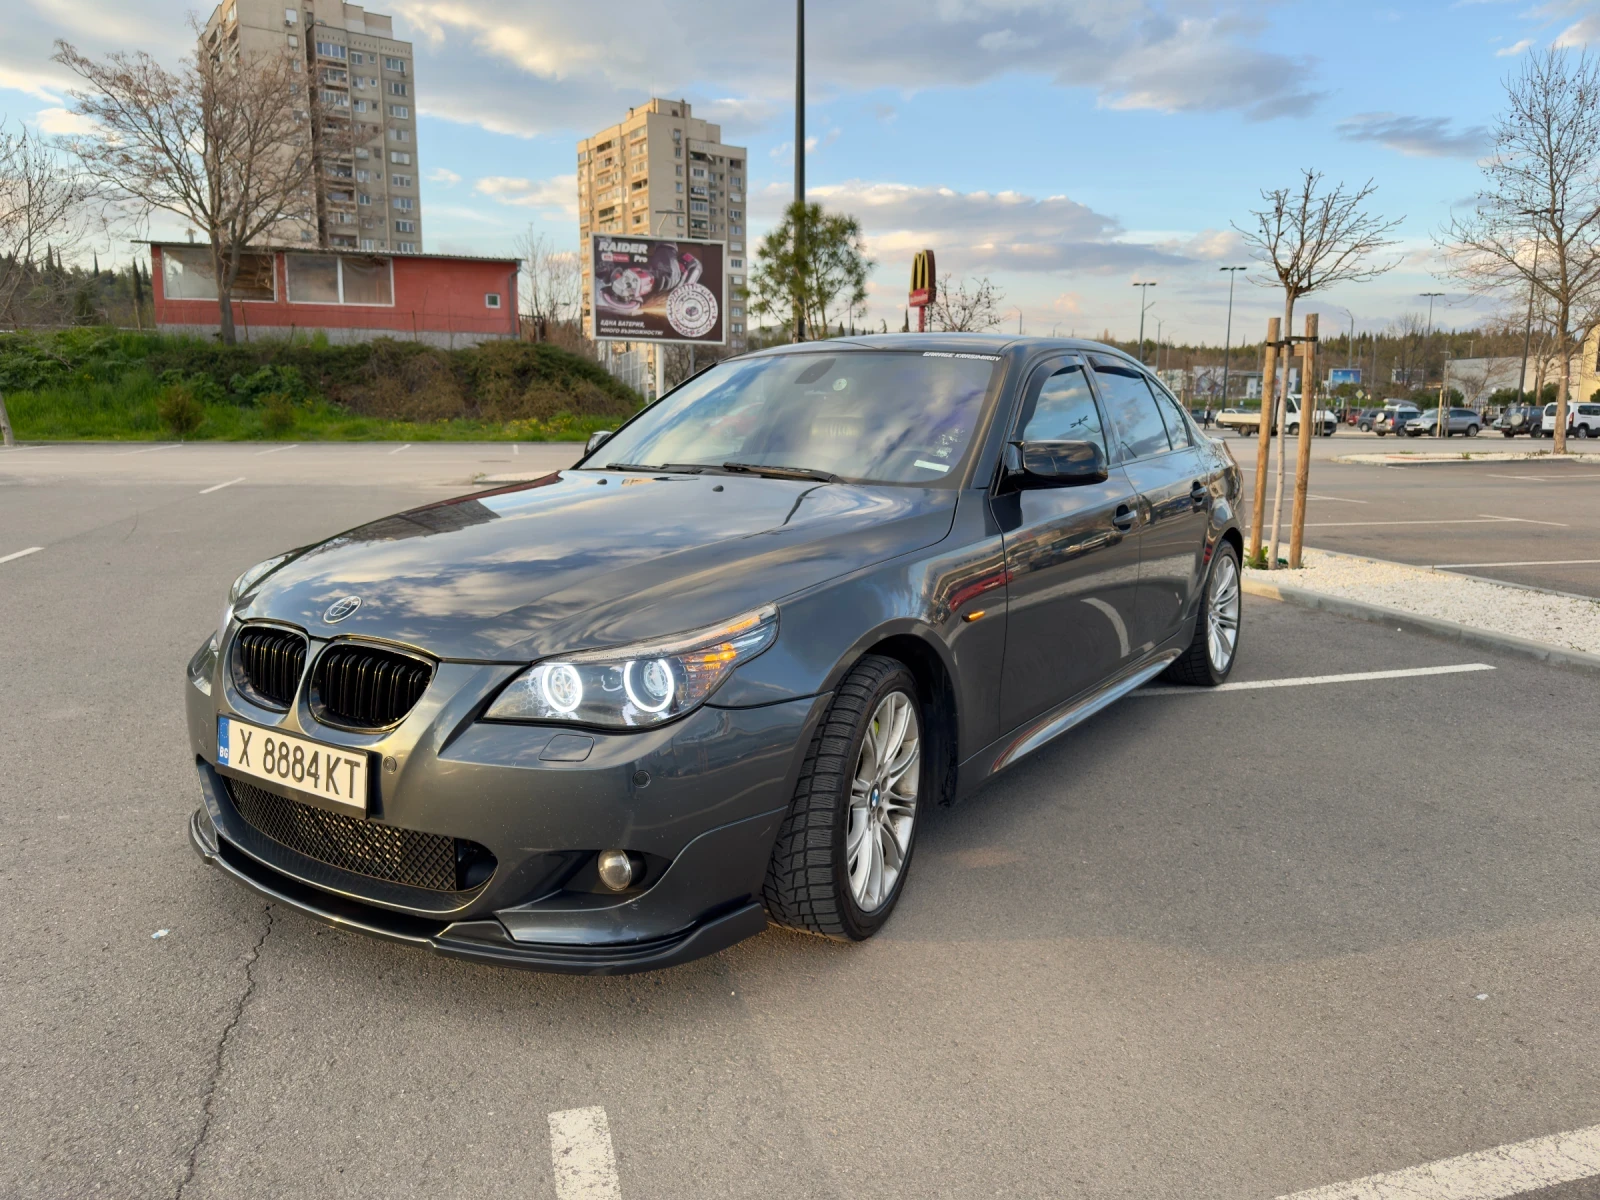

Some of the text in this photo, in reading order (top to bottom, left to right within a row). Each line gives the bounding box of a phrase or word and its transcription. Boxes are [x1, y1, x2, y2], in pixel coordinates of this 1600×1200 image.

[599, 241, 648, 254] RAIDER
[633, 254, 648, 263] Pro
[219, 745, 229, 759] BG
[238, 728, 252, 767] X
